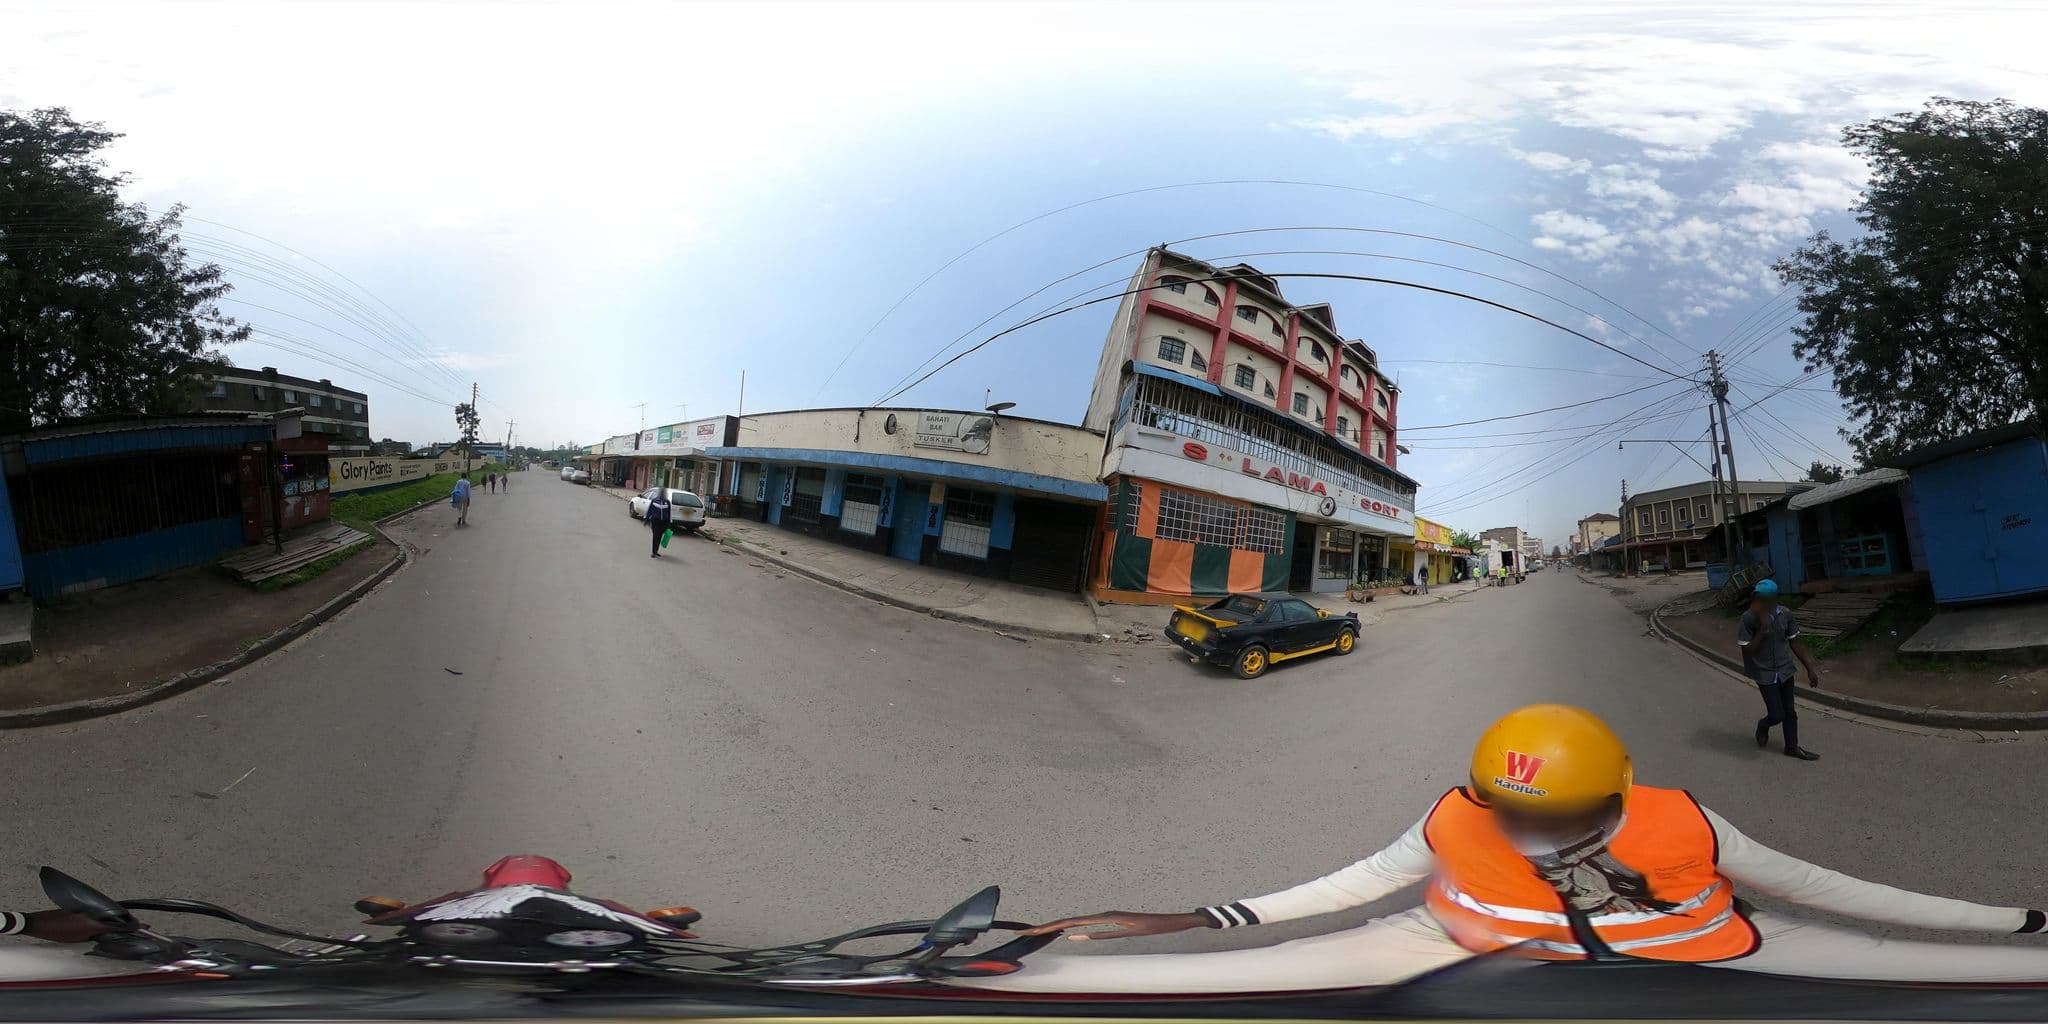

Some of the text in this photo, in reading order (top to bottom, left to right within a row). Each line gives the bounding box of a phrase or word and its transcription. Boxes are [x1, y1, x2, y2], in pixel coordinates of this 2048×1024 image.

[926, 415, 950, 423] BAHATI
[918, 435, 953, 444] TUSKER
[341, 461, 369, 480] Glory
[369, 461, 392, 475] Paints
[928, 505, 938, 528] BAR
